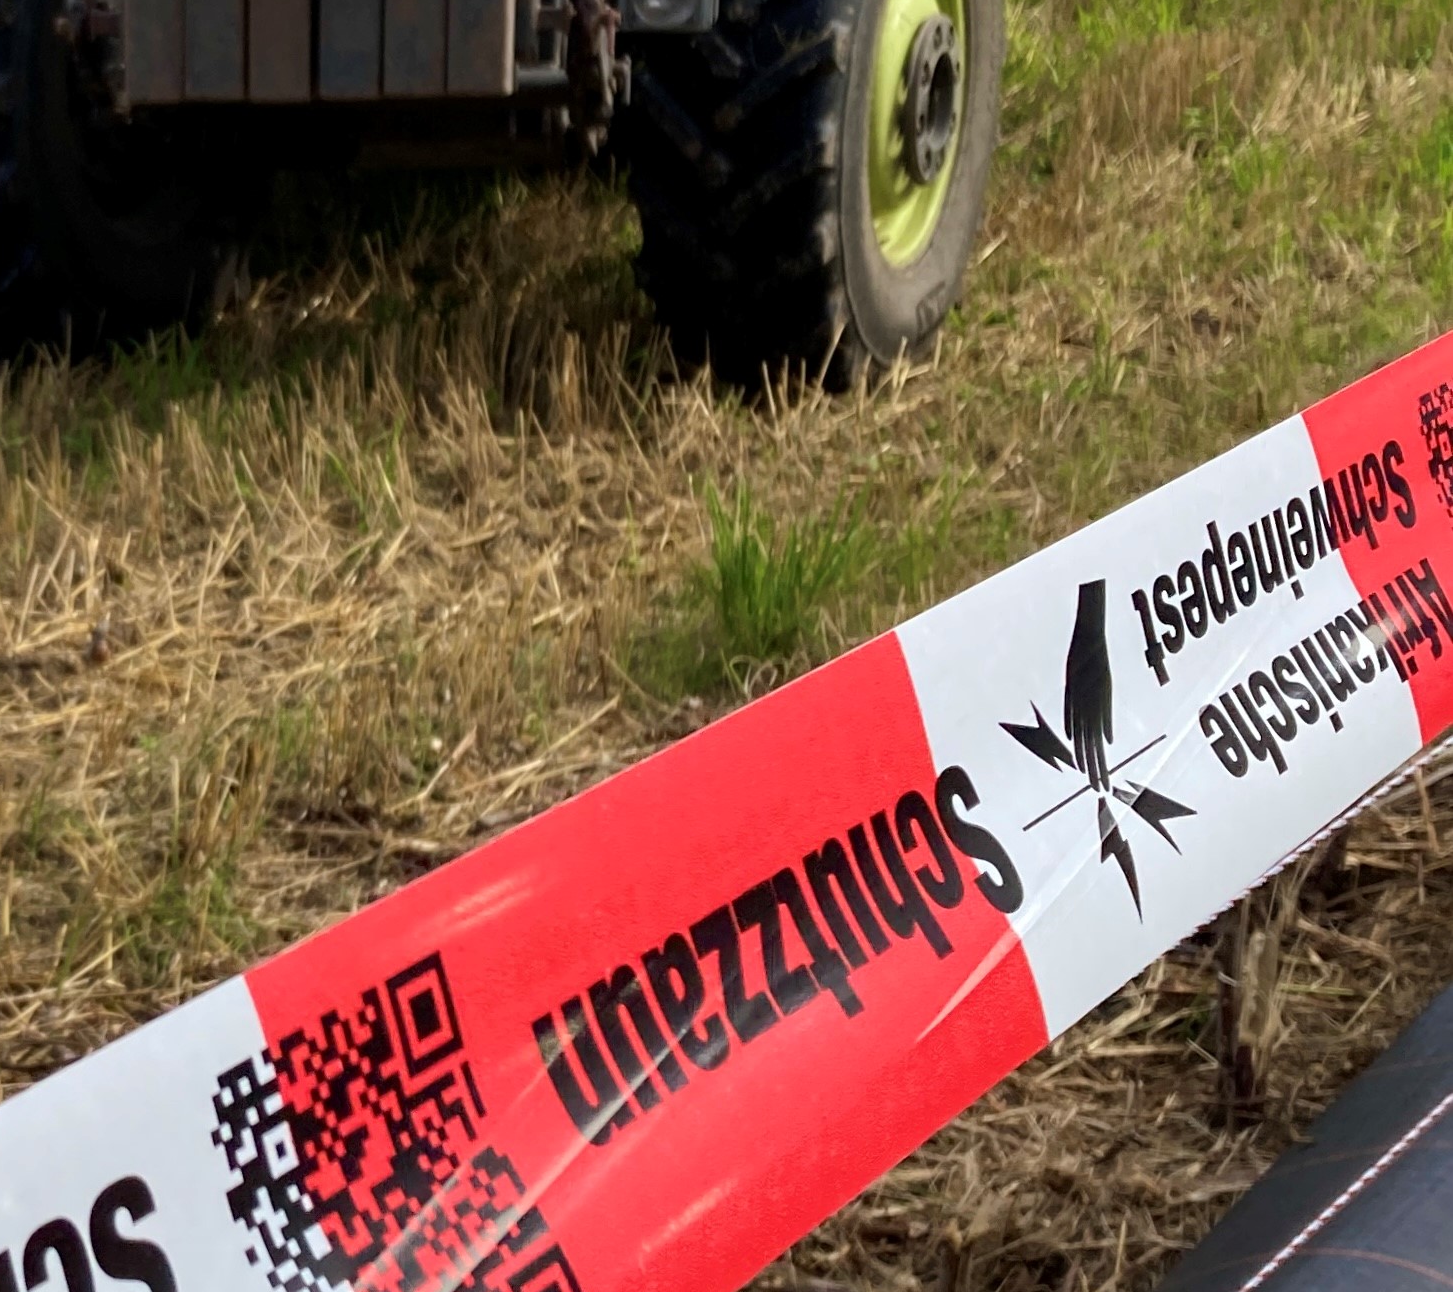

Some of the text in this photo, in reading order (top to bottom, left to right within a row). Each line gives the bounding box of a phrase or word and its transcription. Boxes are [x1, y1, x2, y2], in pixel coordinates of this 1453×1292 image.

[1132, 440, 1416, 686] Schweinepest
[1198, 559, 1453, 778] Afrikanische
[532, 765, 1023, 1147] Schutzzaun
